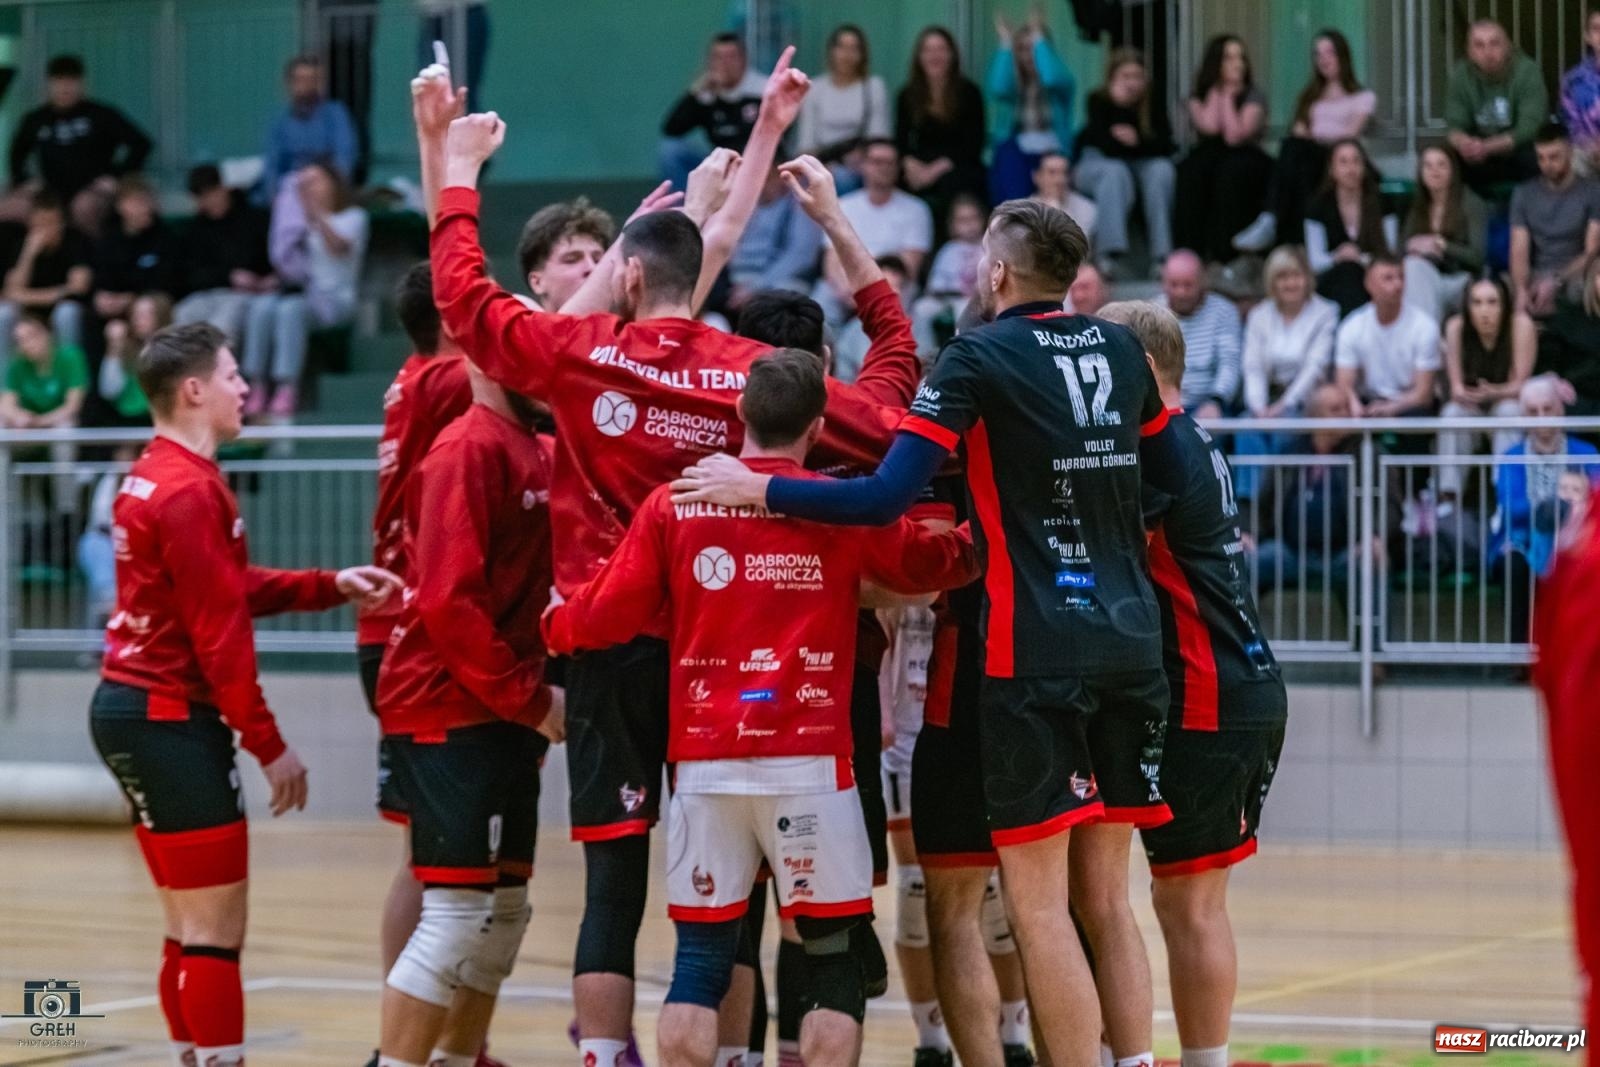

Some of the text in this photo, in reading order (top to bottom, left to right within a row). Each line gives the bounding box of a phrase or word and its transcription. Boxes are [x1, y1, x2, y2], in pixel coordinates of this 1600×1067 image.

[1053, 352, 1122, 428] 12
[1084, 439, 1115, 453] VOLLEY
[1053, 452, 1137, 472] DĄBROWA GÓRNICZA
